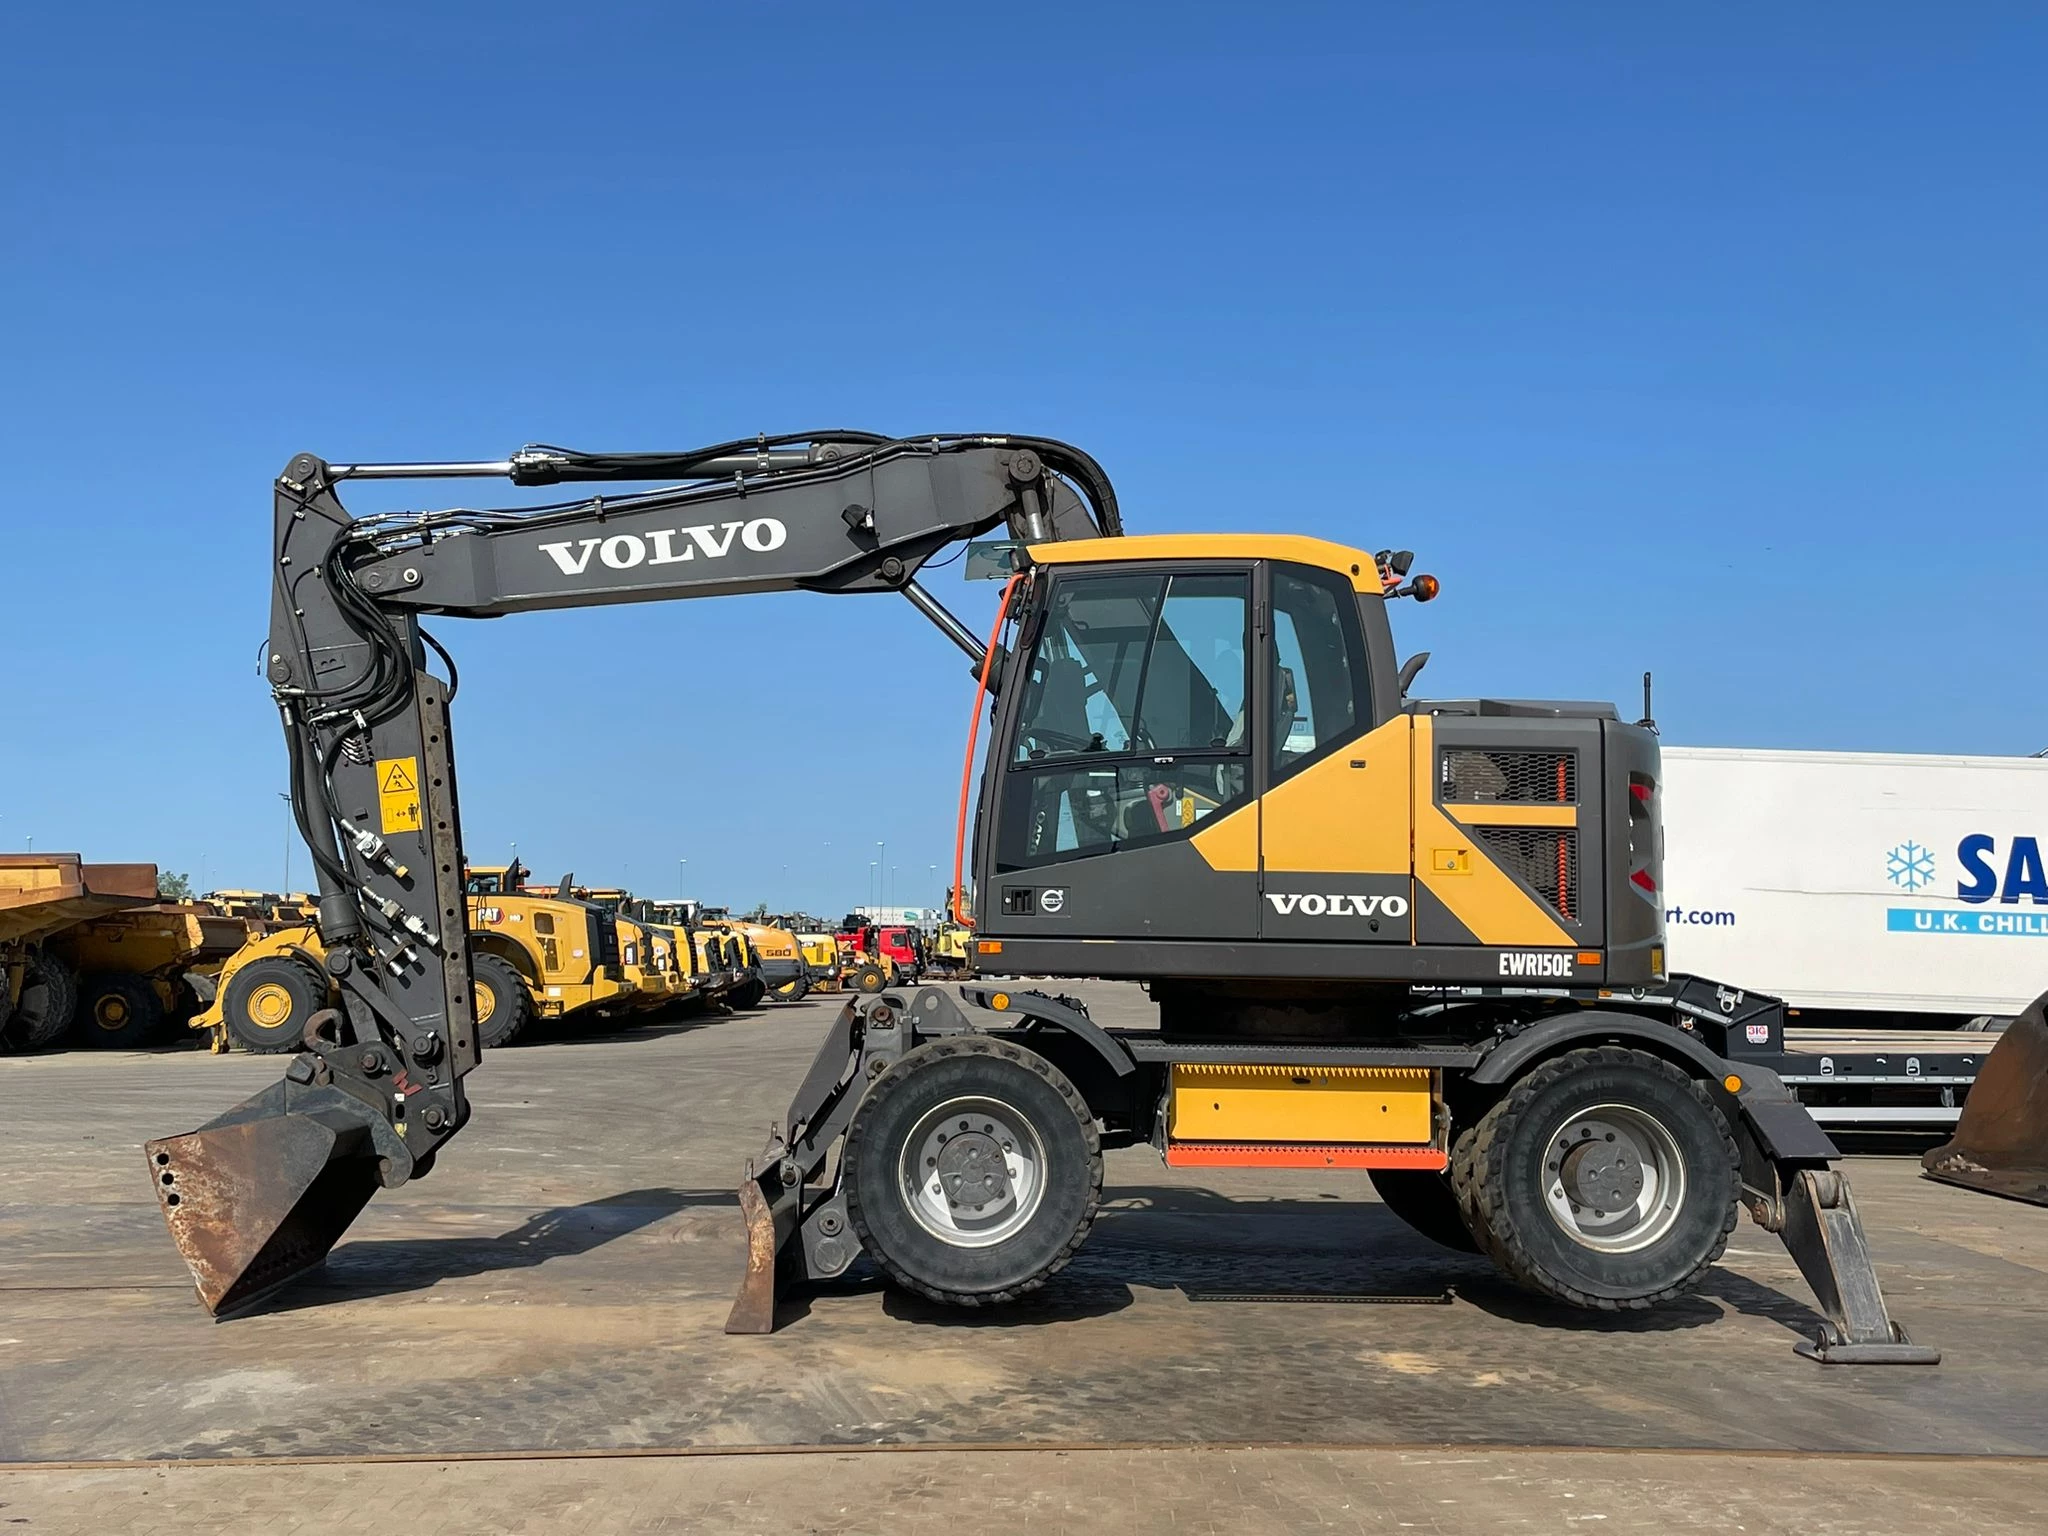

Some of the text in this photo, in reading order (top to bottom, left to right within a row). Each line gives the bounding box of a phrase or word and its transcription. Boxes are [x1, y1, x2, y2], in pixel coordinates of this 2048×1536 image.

[538, 518, 787, 575] VOLVO
[1957, 833, 2048, 905] SA
[1266, 894, 1408, 917] VOLVO
[1666, 906, 1735, 926] rt.com
[1915, 912, 1967, 930] U.K.
[1499, 952, 1573, 976] EWR150E
